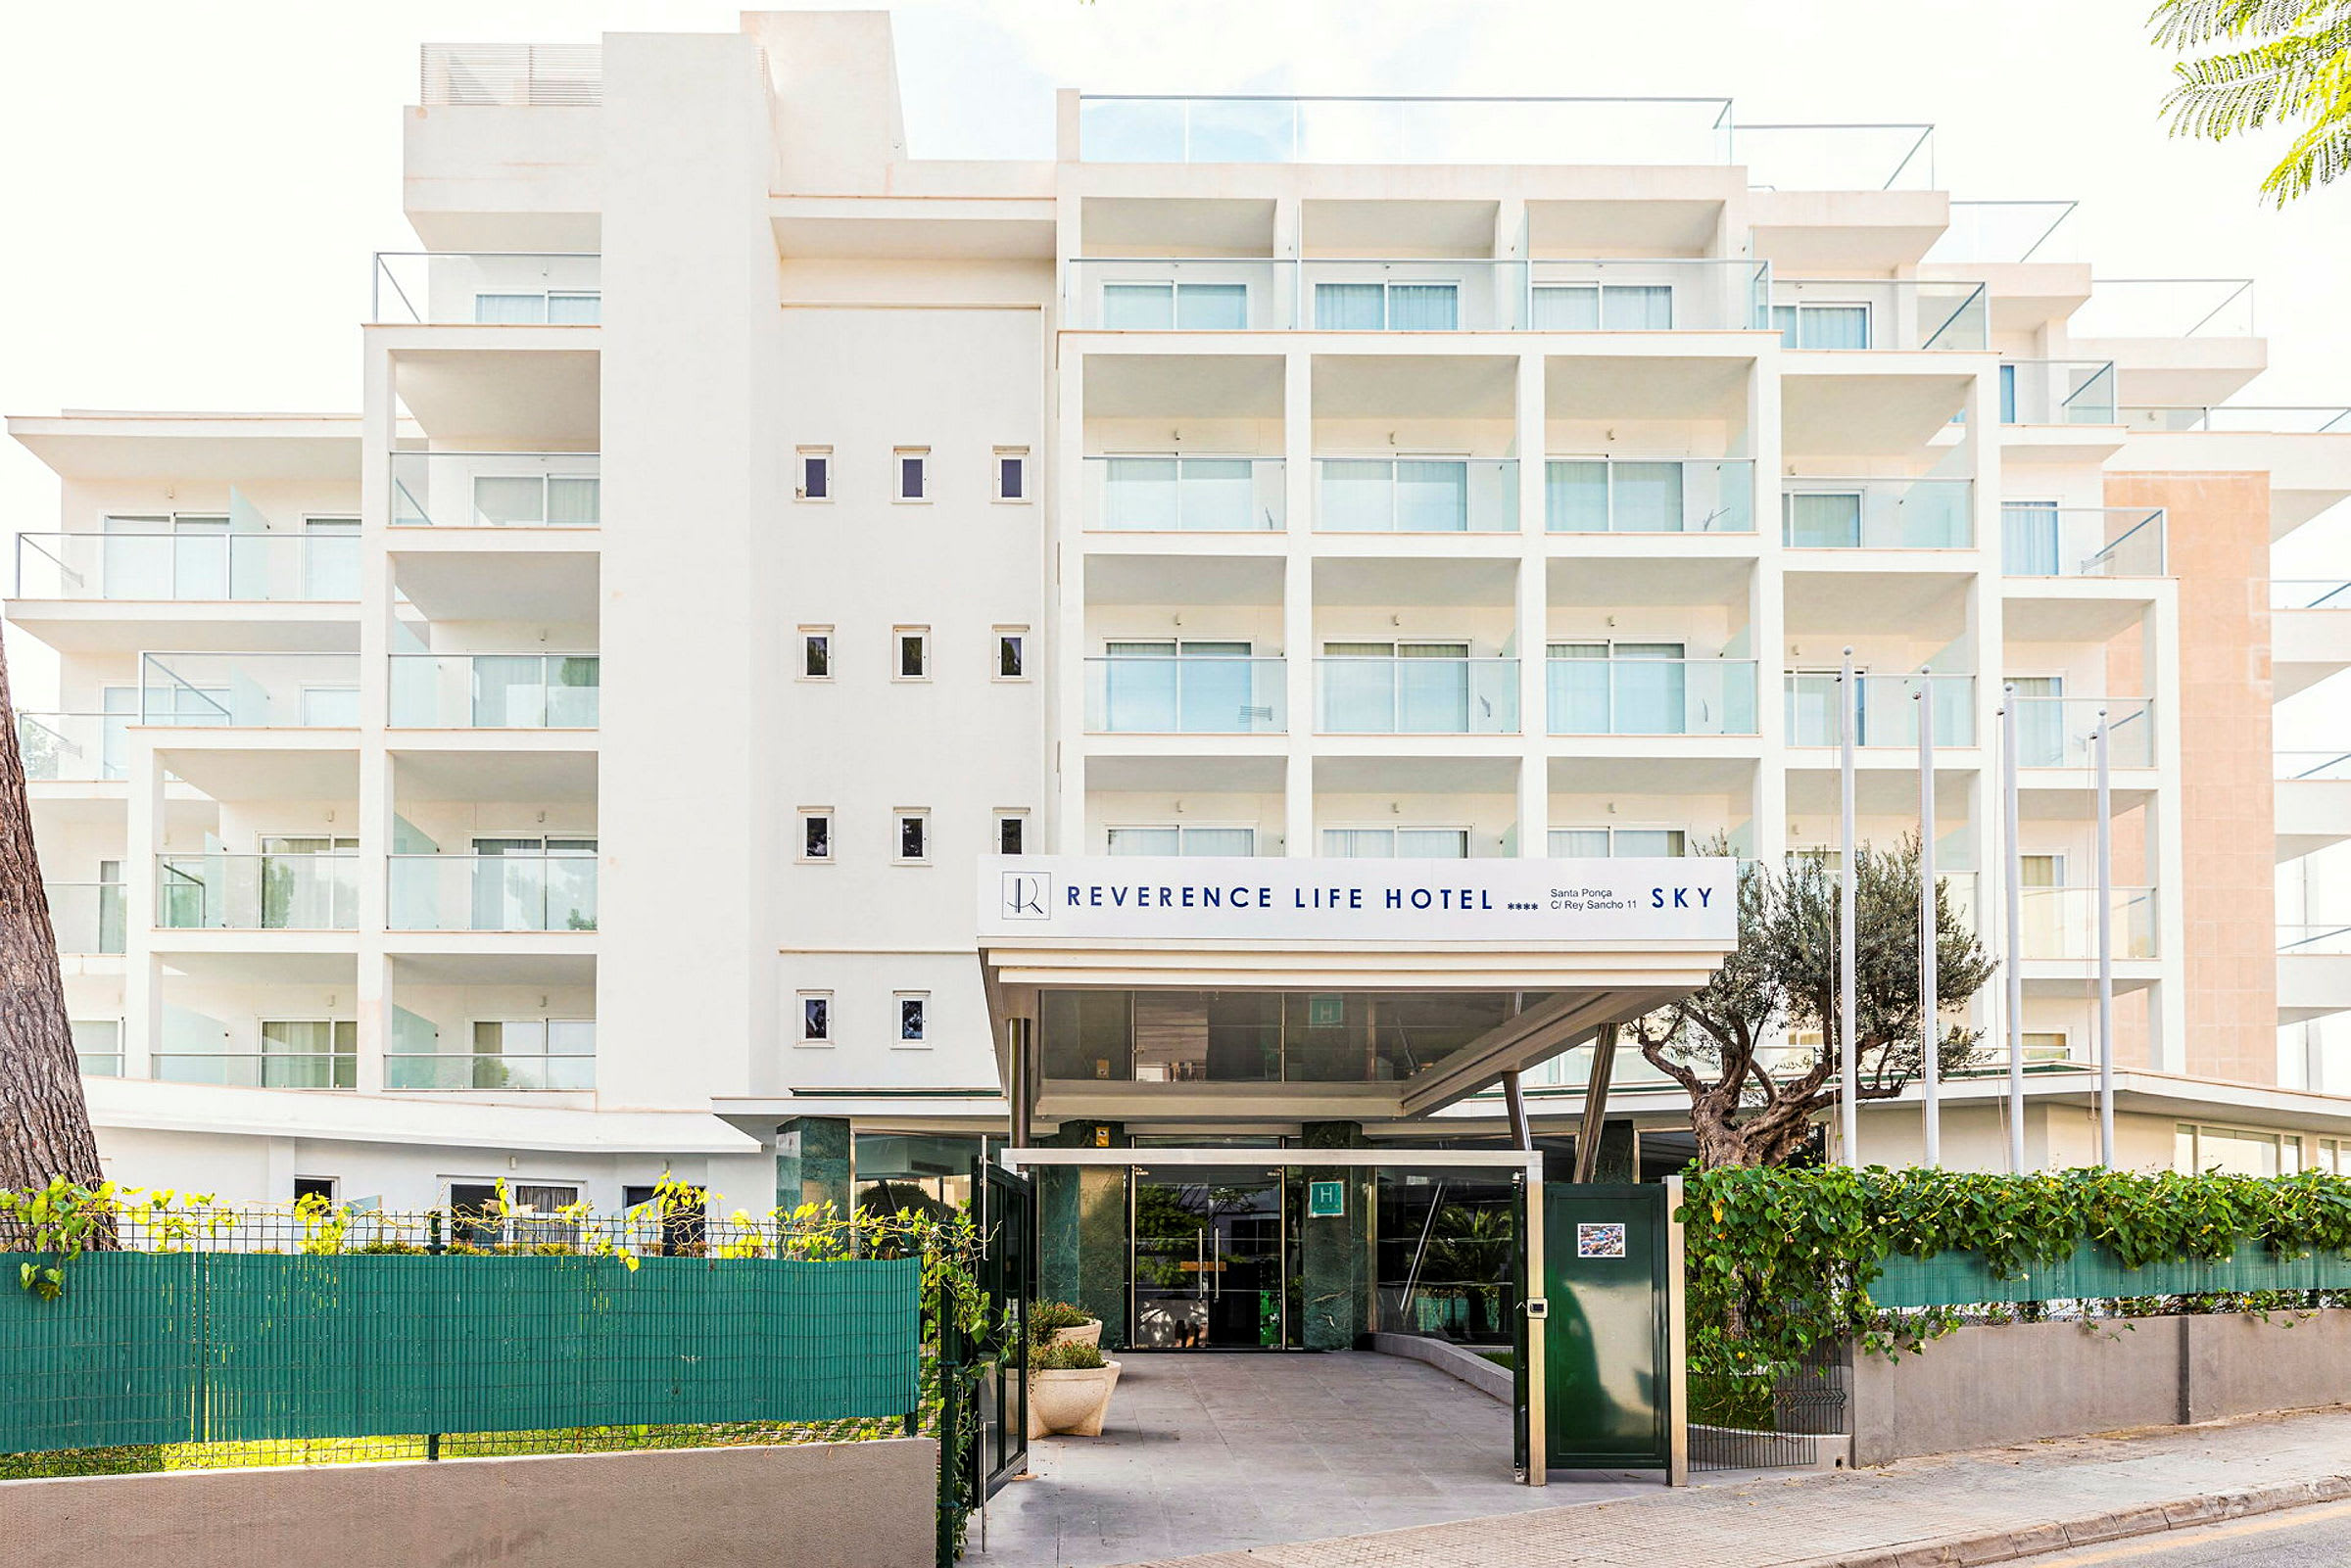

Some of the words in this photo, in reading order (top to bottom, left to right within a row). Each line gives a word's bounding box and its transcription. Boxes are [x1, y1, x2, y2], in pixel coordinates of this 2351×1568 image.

[1067, 886, 1271, 909] REVERENCE
[1295, 887, 1363, 910] LIFE
[1385, 888, 1493, 910] HOTEL
[1550, 888, 1579, 898] Santa
[1581, 888, 1612, 900] Ponça
[1651, 886, 1712, 909] SKY
[1550, 899, 1562, 910] C/
[1564, 899, 1584, 912] Rey
[1587, 899, 1624, 910] Sancho
[1627, 899, 1637, 909] 11
[1319, 1186, 1333, 1204] H
